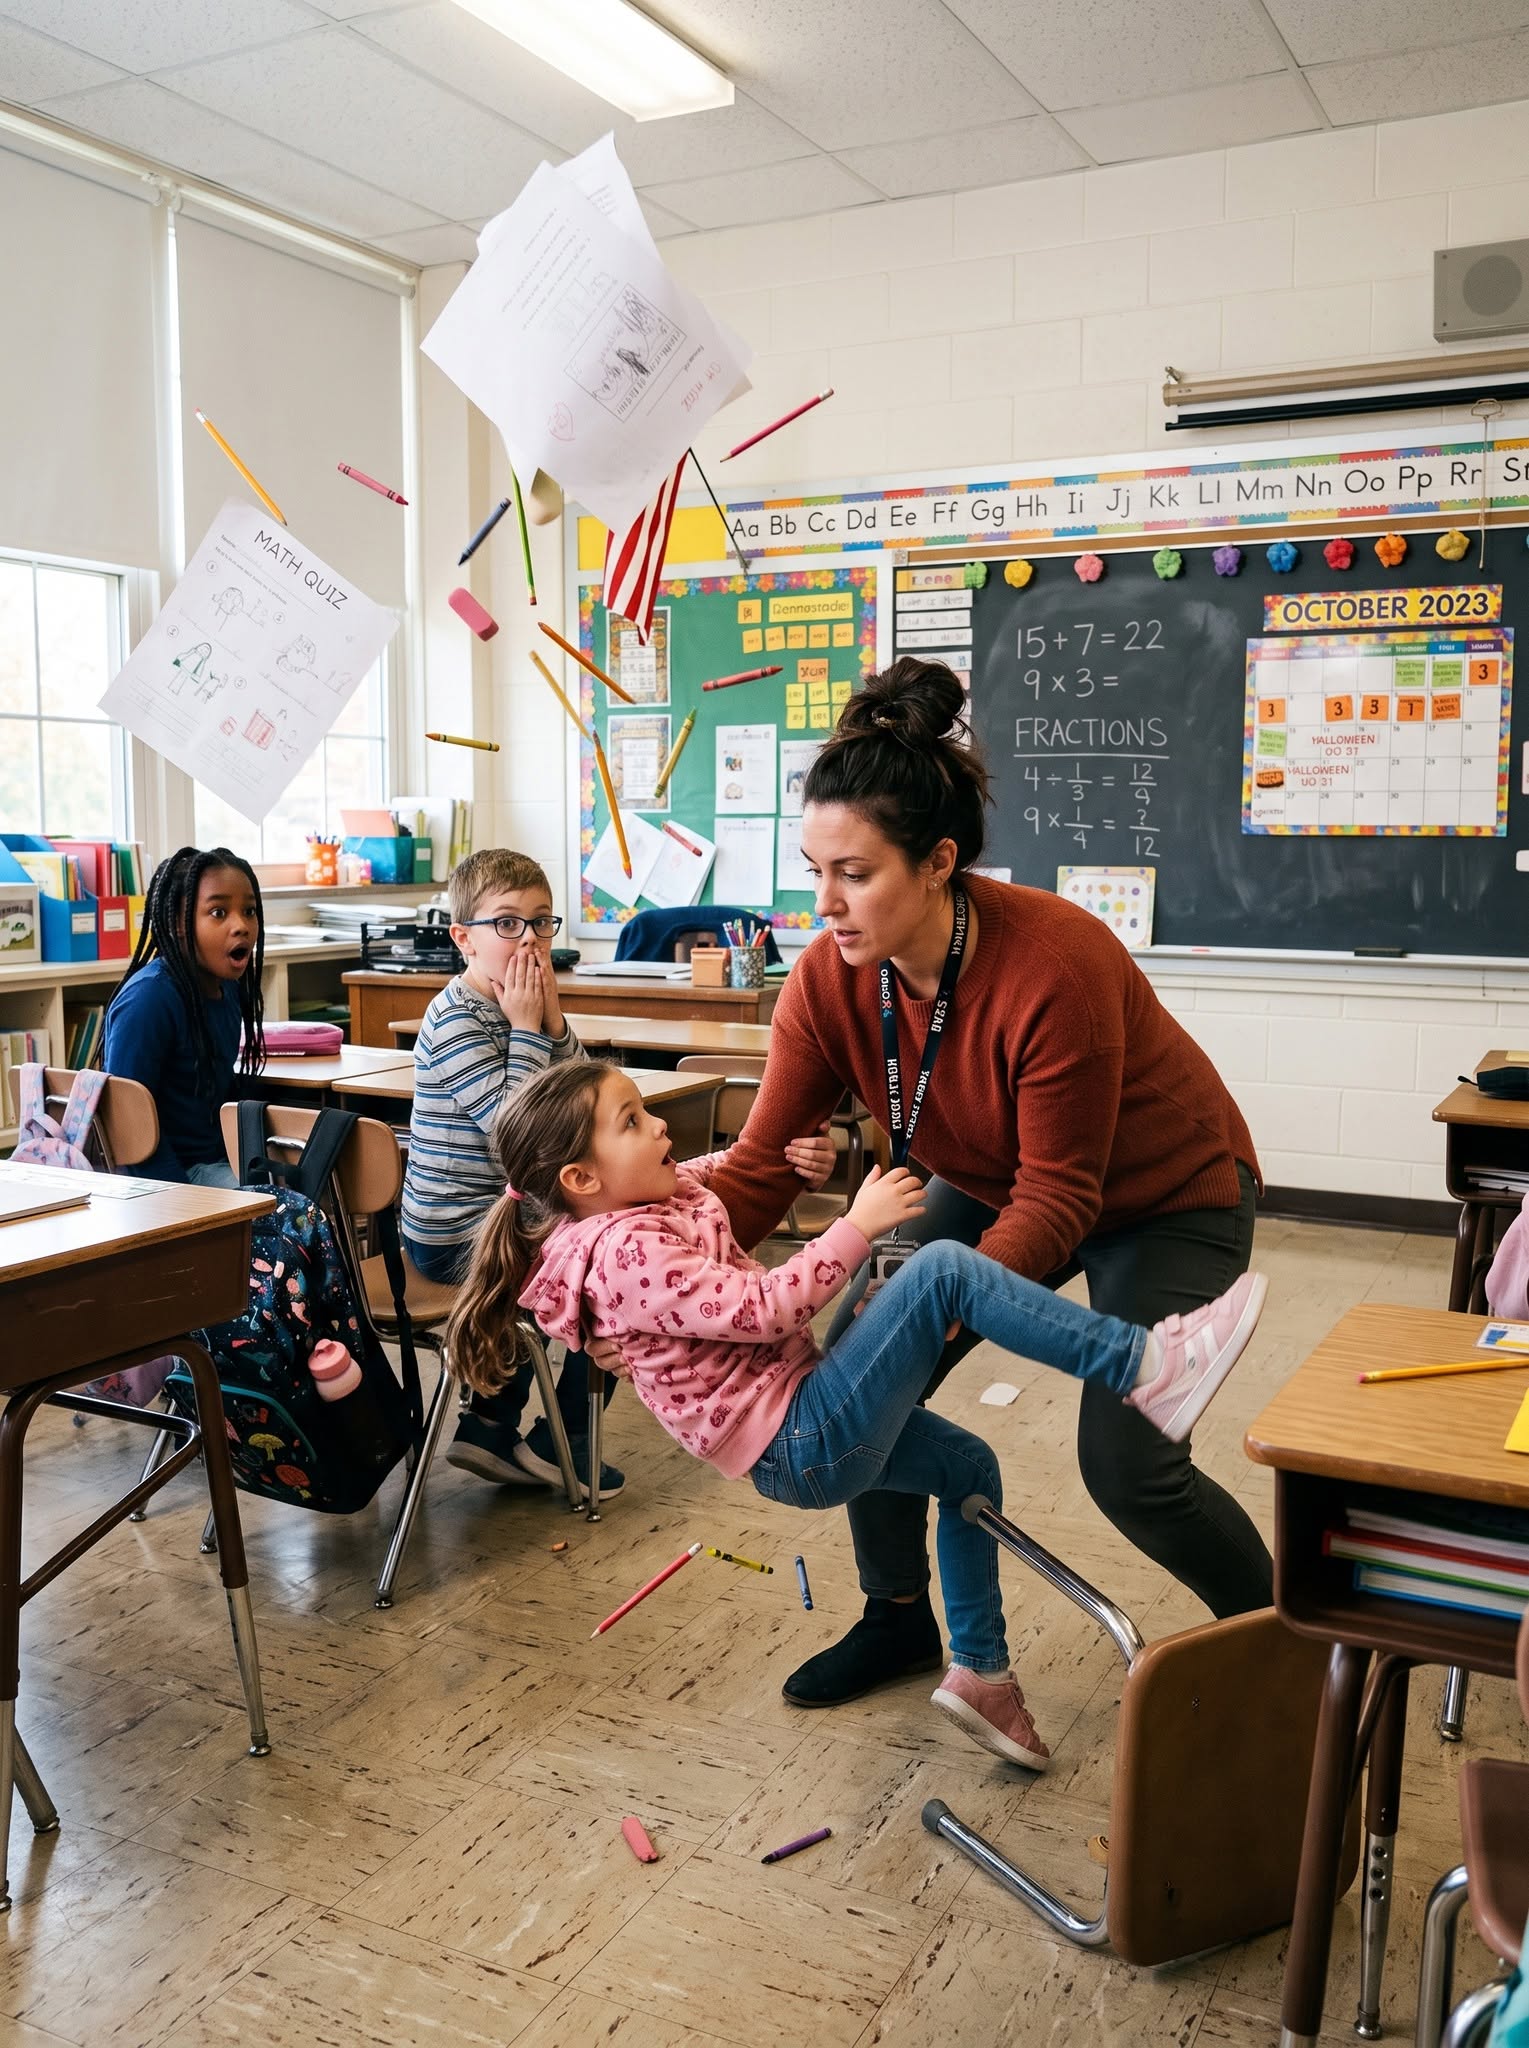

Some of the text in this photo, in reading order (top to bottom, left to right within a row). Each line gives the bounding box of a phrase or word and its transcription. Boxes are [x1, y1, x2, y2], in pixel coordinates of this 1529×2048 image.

[731, 518, 759, 538] Aa
[770, 515, 797, 535] Bb
[808, 512, 836, 532] Cc
[847, 509, 877, 530] Dd
[890, 505, 917, 527] Ee
[933, 501, 958, 524] Ff
[971, 499, 1005, 527] Gg
[1016, 494, 1047, 517] Hh
[1068, 492, 1083, 514] Ii
[1106, 488, 1130, 518] Jj
[1150, 485, 1179, 508] Kk
[1237, 477, 1283, 502] Mm
[1296, 473, 1332, 497] Nn
[1345, 469, 1385, 493] Oo
[1398, 465, 1432, 497] Pp
[1450, 461, 1482, 486] Rr
[254, 530, 303, 575] MATH
[304, 570, 348, 610] QUIZ
[1282, 592, 1489, 624] OCTOBER 2023
[1478, 664, 1488, 680] 3
[1268, 703, 1275, 717] 3
[1334, 701, 1343, 716] 3
[1015, 717, 1168, 748] FRACTIONS
